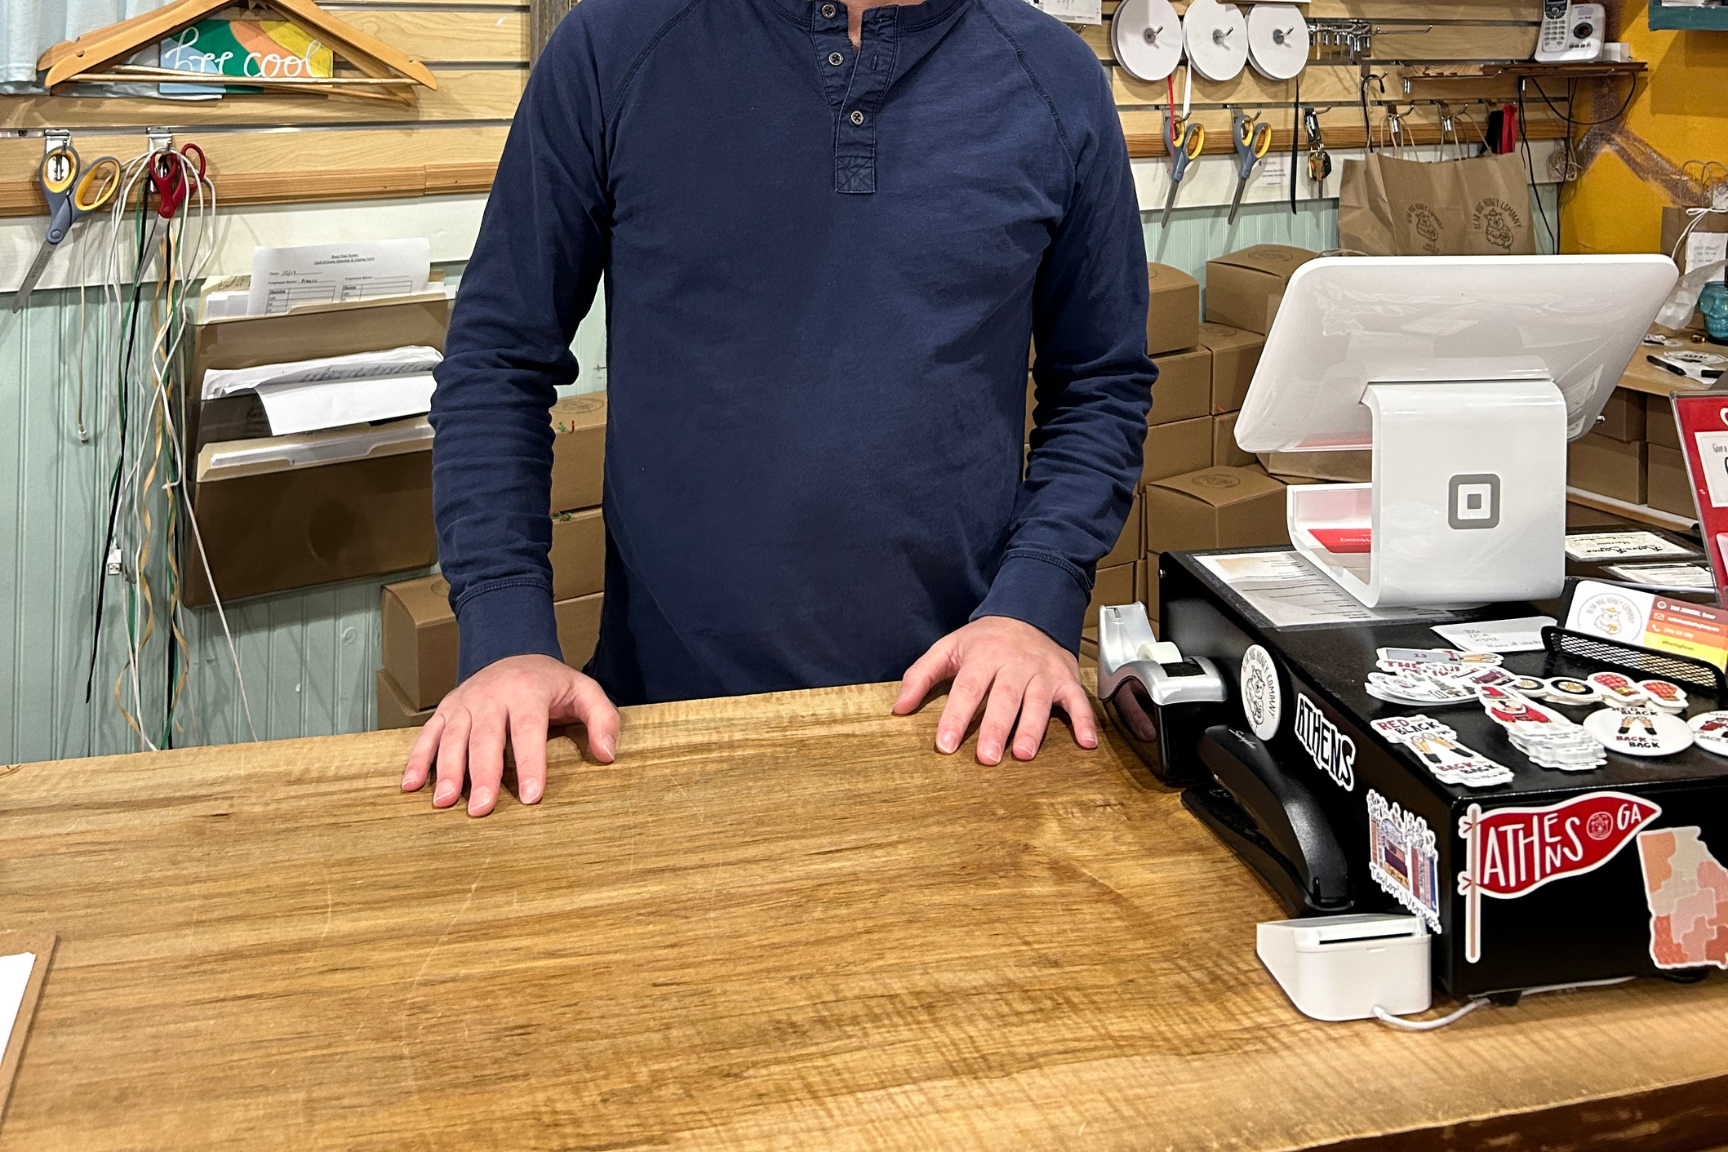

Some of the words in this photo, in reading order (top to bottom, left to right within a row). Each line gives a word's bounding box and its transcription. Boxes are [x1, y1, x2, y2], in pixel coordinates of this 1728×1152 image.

[243, 39, 324, 78] cool
[1297, 696, 1355, 788] ATHENS
[1377, 718, 1410, 731] RED
[1394, 721, 1441, 736] BLACK
[1483, 812, 1584, 887] ATHENS
[1616, 804, 1642, 831] GA
